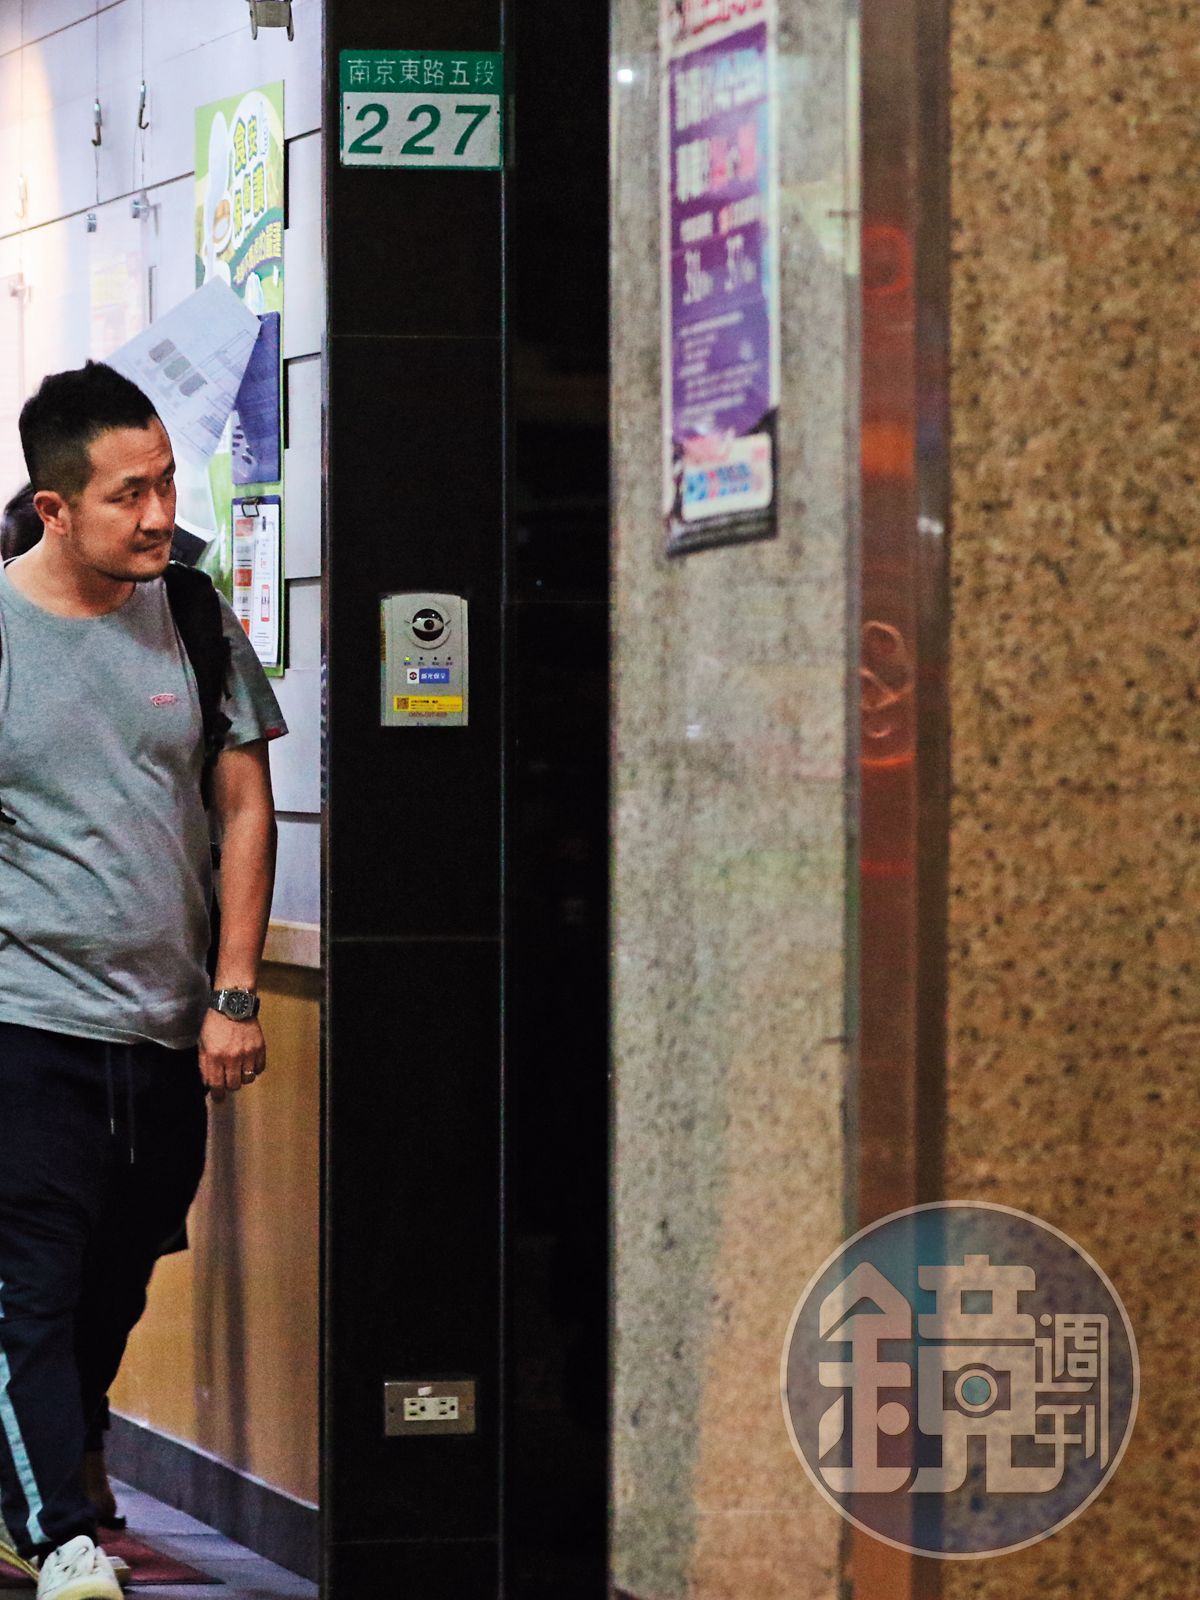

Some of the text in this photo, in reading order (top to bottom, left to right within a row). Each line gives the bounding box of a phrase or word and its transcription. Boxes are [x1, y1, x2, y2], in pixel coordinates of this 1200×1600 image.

[347, 59, 494, 86] 南京東路五段
[348, 103, 491, 156] 227
